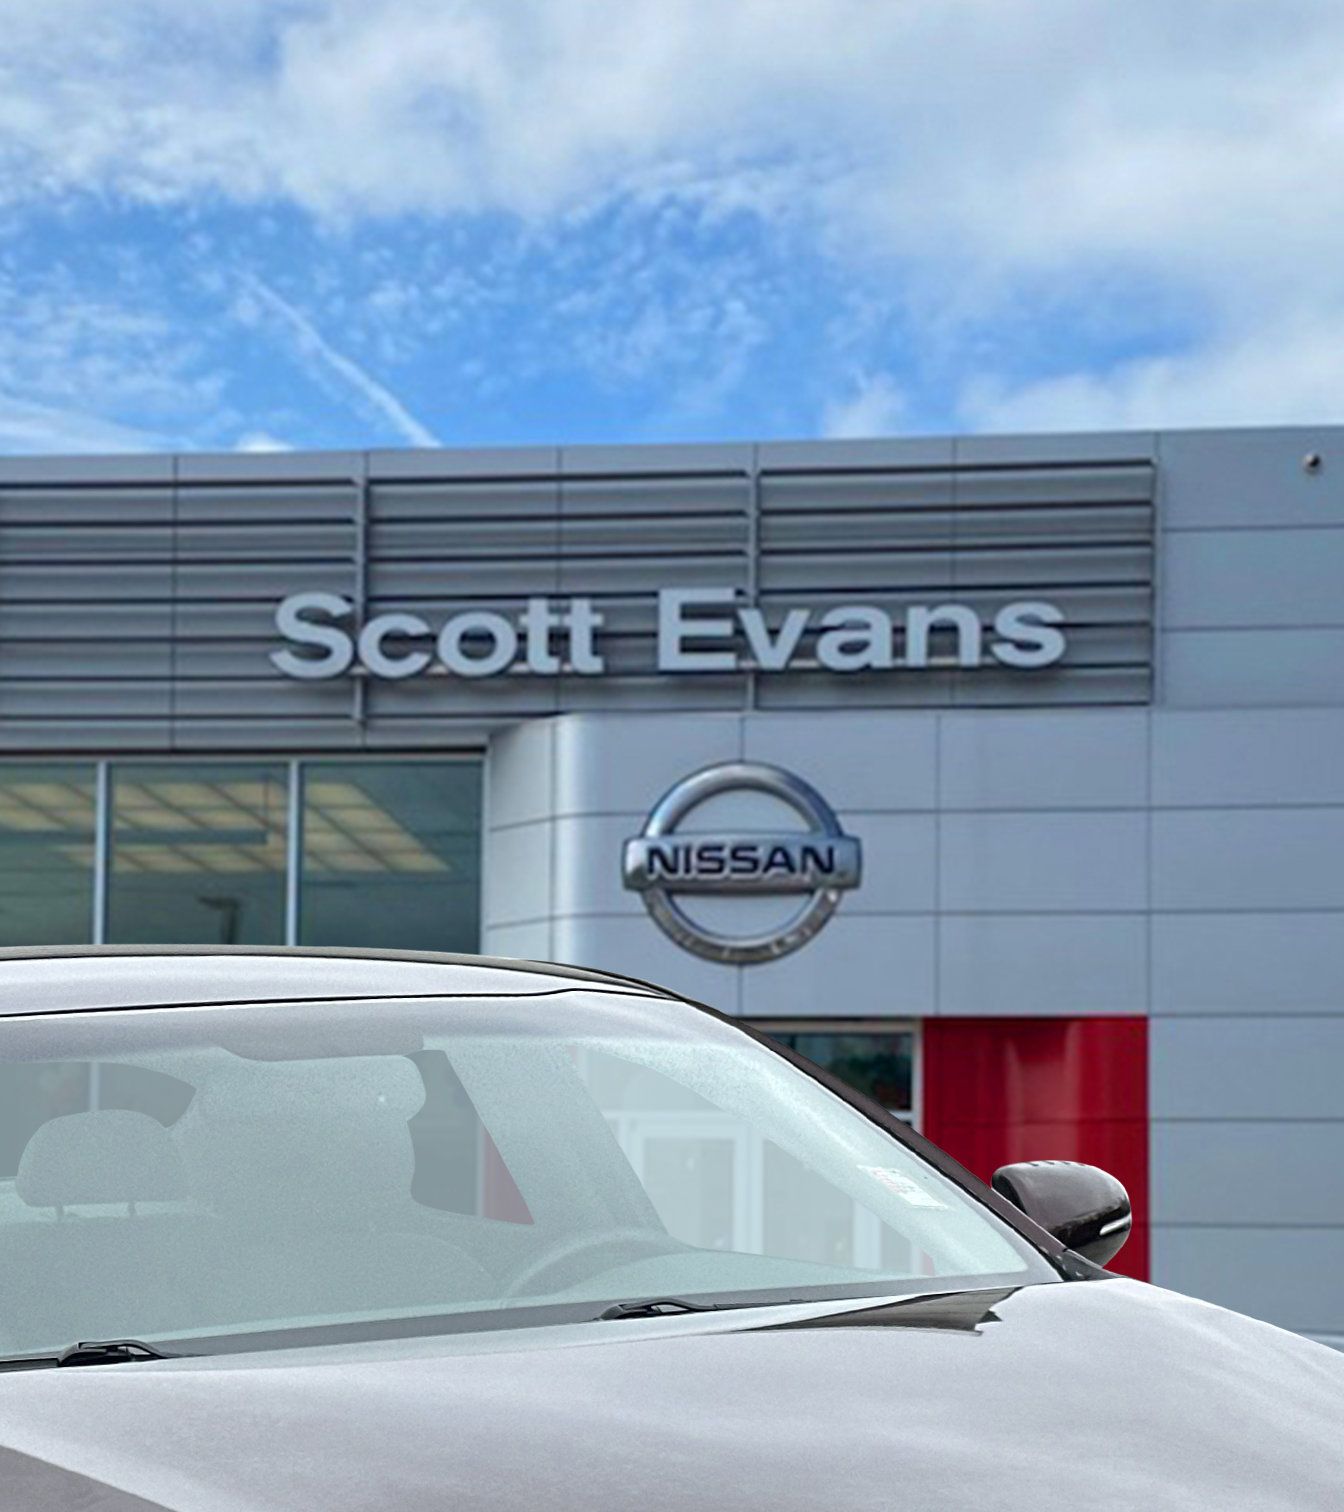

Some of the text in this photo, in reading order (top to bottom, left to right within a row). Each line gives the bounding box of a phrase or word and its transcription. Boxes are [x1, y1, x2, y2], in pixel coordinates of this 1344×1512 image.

[268, 587, 1068, 680] Scott Evans
[646, 845, 835, 876] NISSAN
